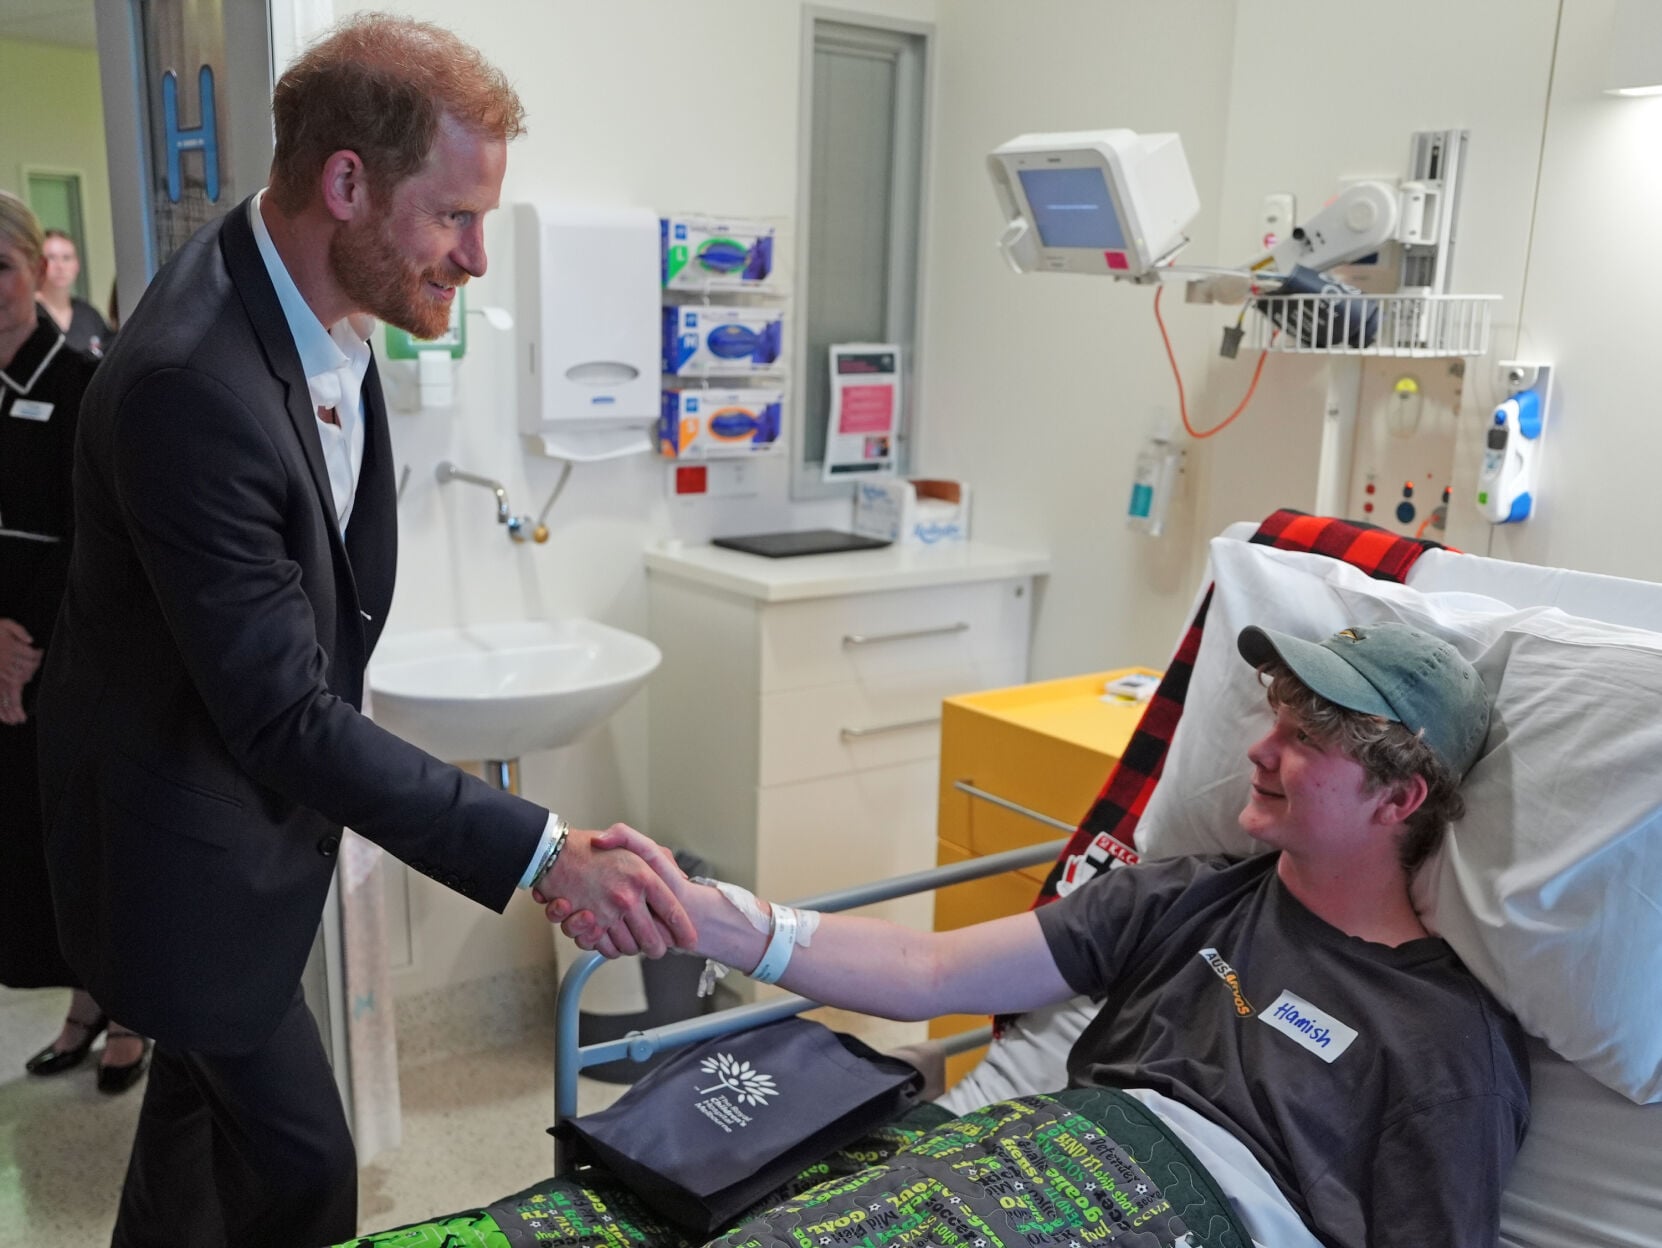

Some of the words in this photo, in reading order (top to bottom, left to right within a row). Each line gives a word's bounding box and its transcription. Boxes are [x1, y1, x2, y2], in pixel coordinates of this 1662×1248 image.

[1273, 1002, 1332, 1048] Hamish
[694, 1102, 733, 1133] Melbourne
[702, 1099, 735, 1125] Hospital
[710, 1097, 748, 1128] Children's
[719, 1094, 733, 1108] The
[731, 1103, 753, 1122] Royal
[1054, 1132, 1088, 1158] BEND
[1090, 1138, 1141, 1184] Defender
[1046, 1168, 1104, 1223] goalie
[1112, 1190, 1139, 1216] shot
[807, 1211, 866, 1235] GOAL
[867, 1211, 899, 1230] Mid
[899, 1215, 938, 1242] PASS
[1080, 1219, 1111, 1243] foul
